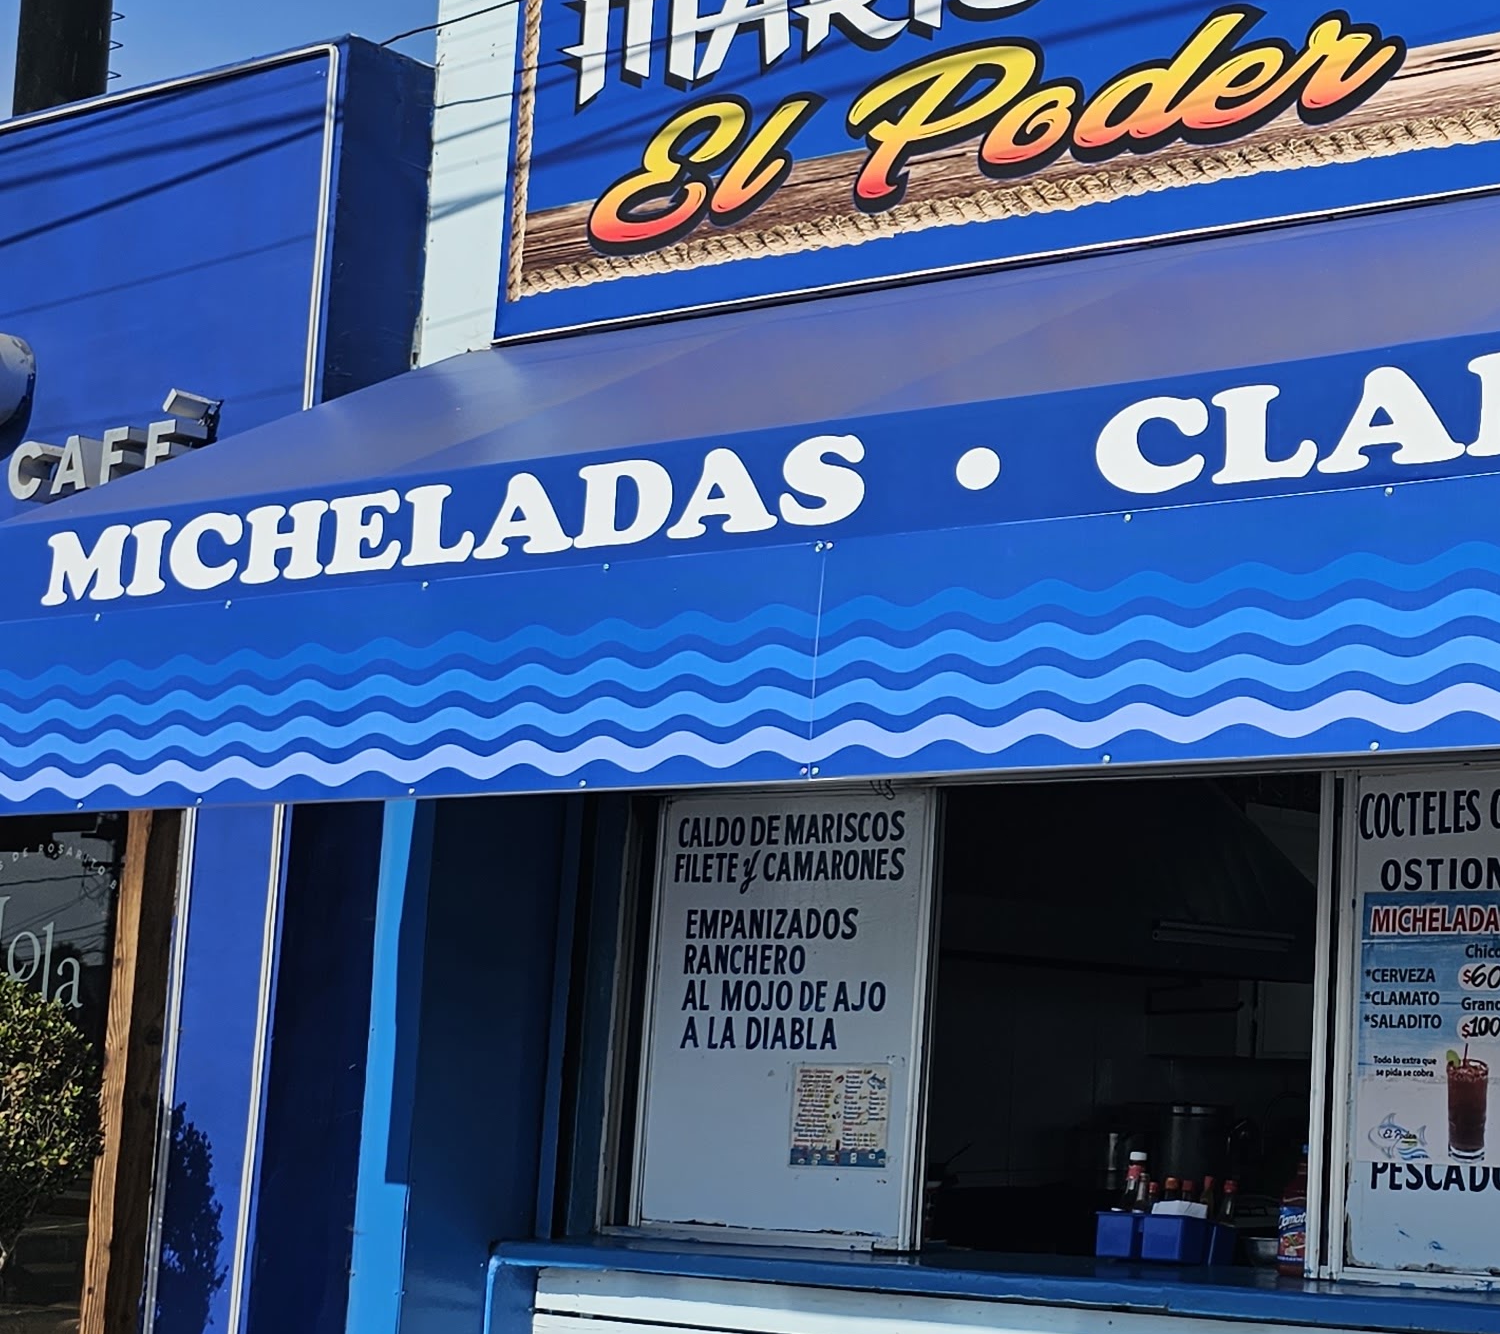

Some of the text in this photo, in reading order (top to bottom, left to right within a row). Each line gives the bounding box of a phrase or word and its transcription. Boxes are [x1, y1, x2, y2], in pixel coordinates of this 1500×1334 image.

[588, 6, 1407, 256] El Poder
[41, 431, 868, 607] MICHELADAS
[678, 810, 906, 849] CALDO DE MARISCOS
[1359, 788, 1482, 841] COCTELES
[38, 843, 106, 876] ROSARITO
[674, 848, 906, 894] FILETE y CAMARONES
[685, 907, 860, 940] EMPANIZADOS
[683, 943, 806, 976] RANCHERO
[681, 979, 887, 1013] AL MOJO DE AJO
[680, 1017, 838, 1051] A LA DIABLA
[1373, 1055, 1437, 1066] Todo lo extra que
[1385, 1067, 1402, 1077] pida
[1412, 1068, 1434, 1077] cobra
